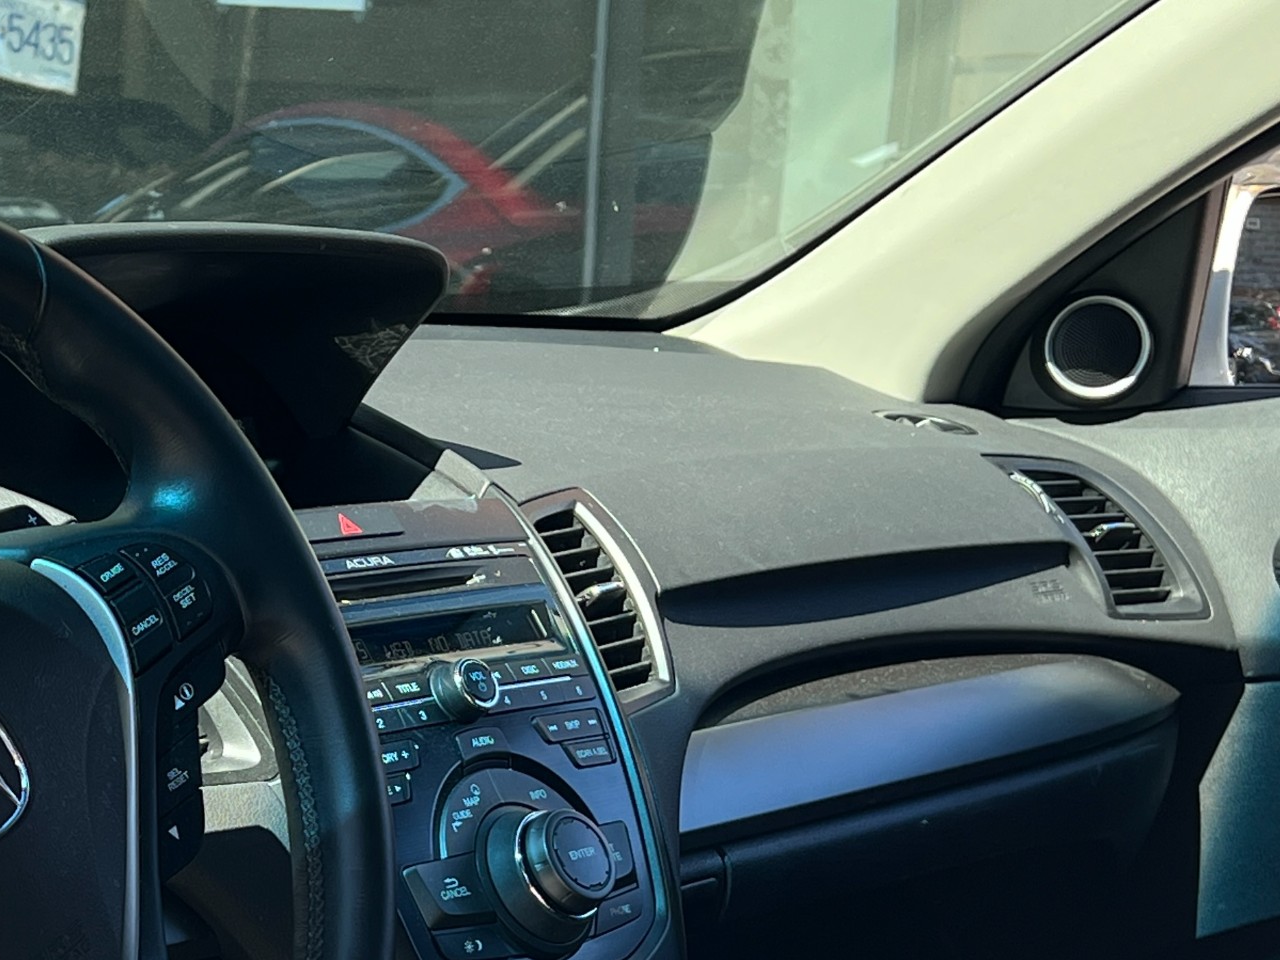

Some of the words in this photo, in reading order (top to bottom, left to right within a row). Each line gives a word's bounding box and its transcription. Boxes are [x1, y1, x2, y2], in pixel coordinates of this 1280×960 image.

[151, 552, 170, 569] RES
[345, 555, 395, 570] ACURA
[156, 560, 178, 577] ACCEL
[180, 592, 196, 608] SET
[131, 614, 160, 636] CANCEL
[468, 671, 487, 682] VOL
[395, 682, 421, 694] TITLE
[540, 690, 548, 701] 5
[418, 710, 428, 721] 3
[376, 718, 386, 729] 2
[472, 736, 495, 748] AUDIO
[568, 846, 596, 861] ENTER
[440, 887, 472, 900] CANCEL
